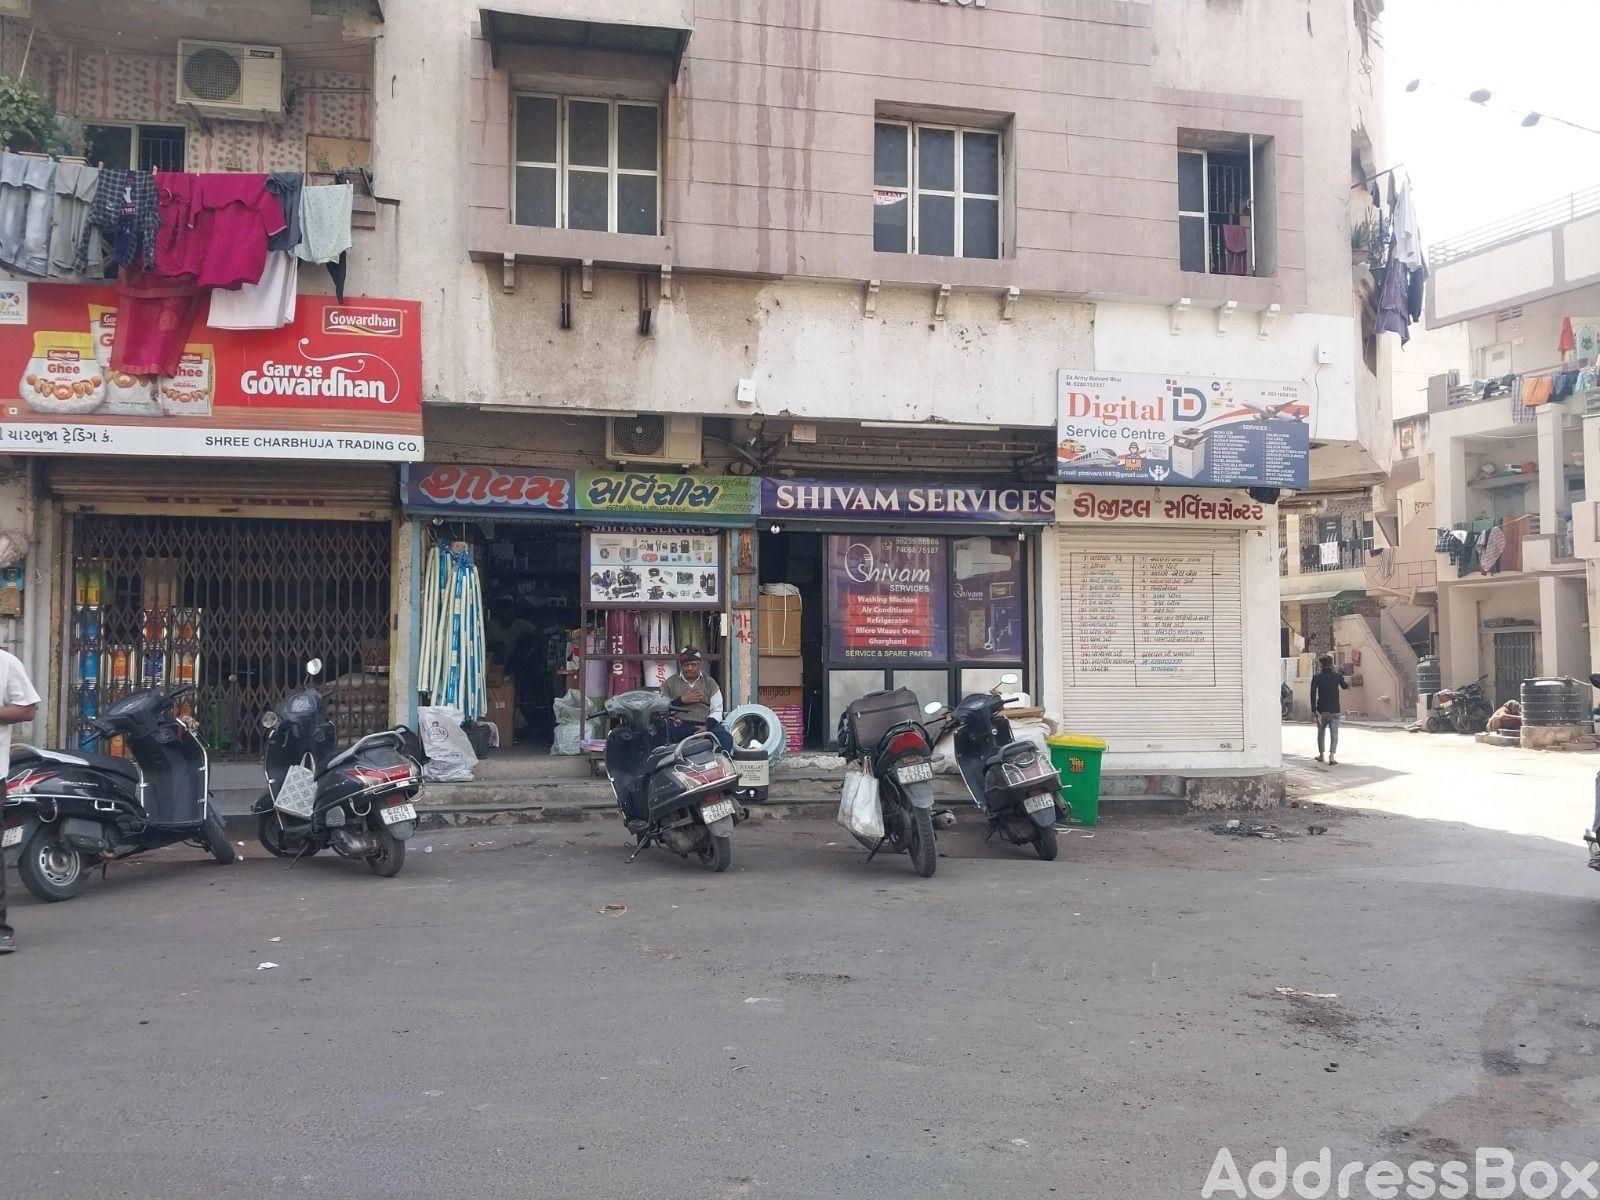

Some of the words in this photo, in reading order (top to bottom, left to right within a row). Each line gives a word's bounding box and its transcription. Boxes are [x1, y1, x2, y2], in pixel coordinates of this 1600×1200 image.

[329, 311, 396, 327] Gowardhan
[47, 363, 81, 374] Ghee
[263, 360, 302, 377] Garv
[304, 364, 323, 377] se
[240, 366, 398, 403] Gowardhan
[1066, 392, 1165, 426] Digital
[1066, 425, 1117, 439] Service
[1121, 427, 1166, 440] Centre
[205, 436, 250, 447] SHREE
[253, 437, 334, 449] CHARBHUJA
[337, 439, 395, 451] TRADING
[398, 441, 420, 453] CO.
[776, 485, 900, 511] SHIVAM
[907, 488, 1056, 514] SERVICES
[889, 584, 930, 592] SERVICES
[857, 596, 888, 604] Washing
[866, 617, 909, 626] Refrigerator
[901, 627, 920, 635] Oven
